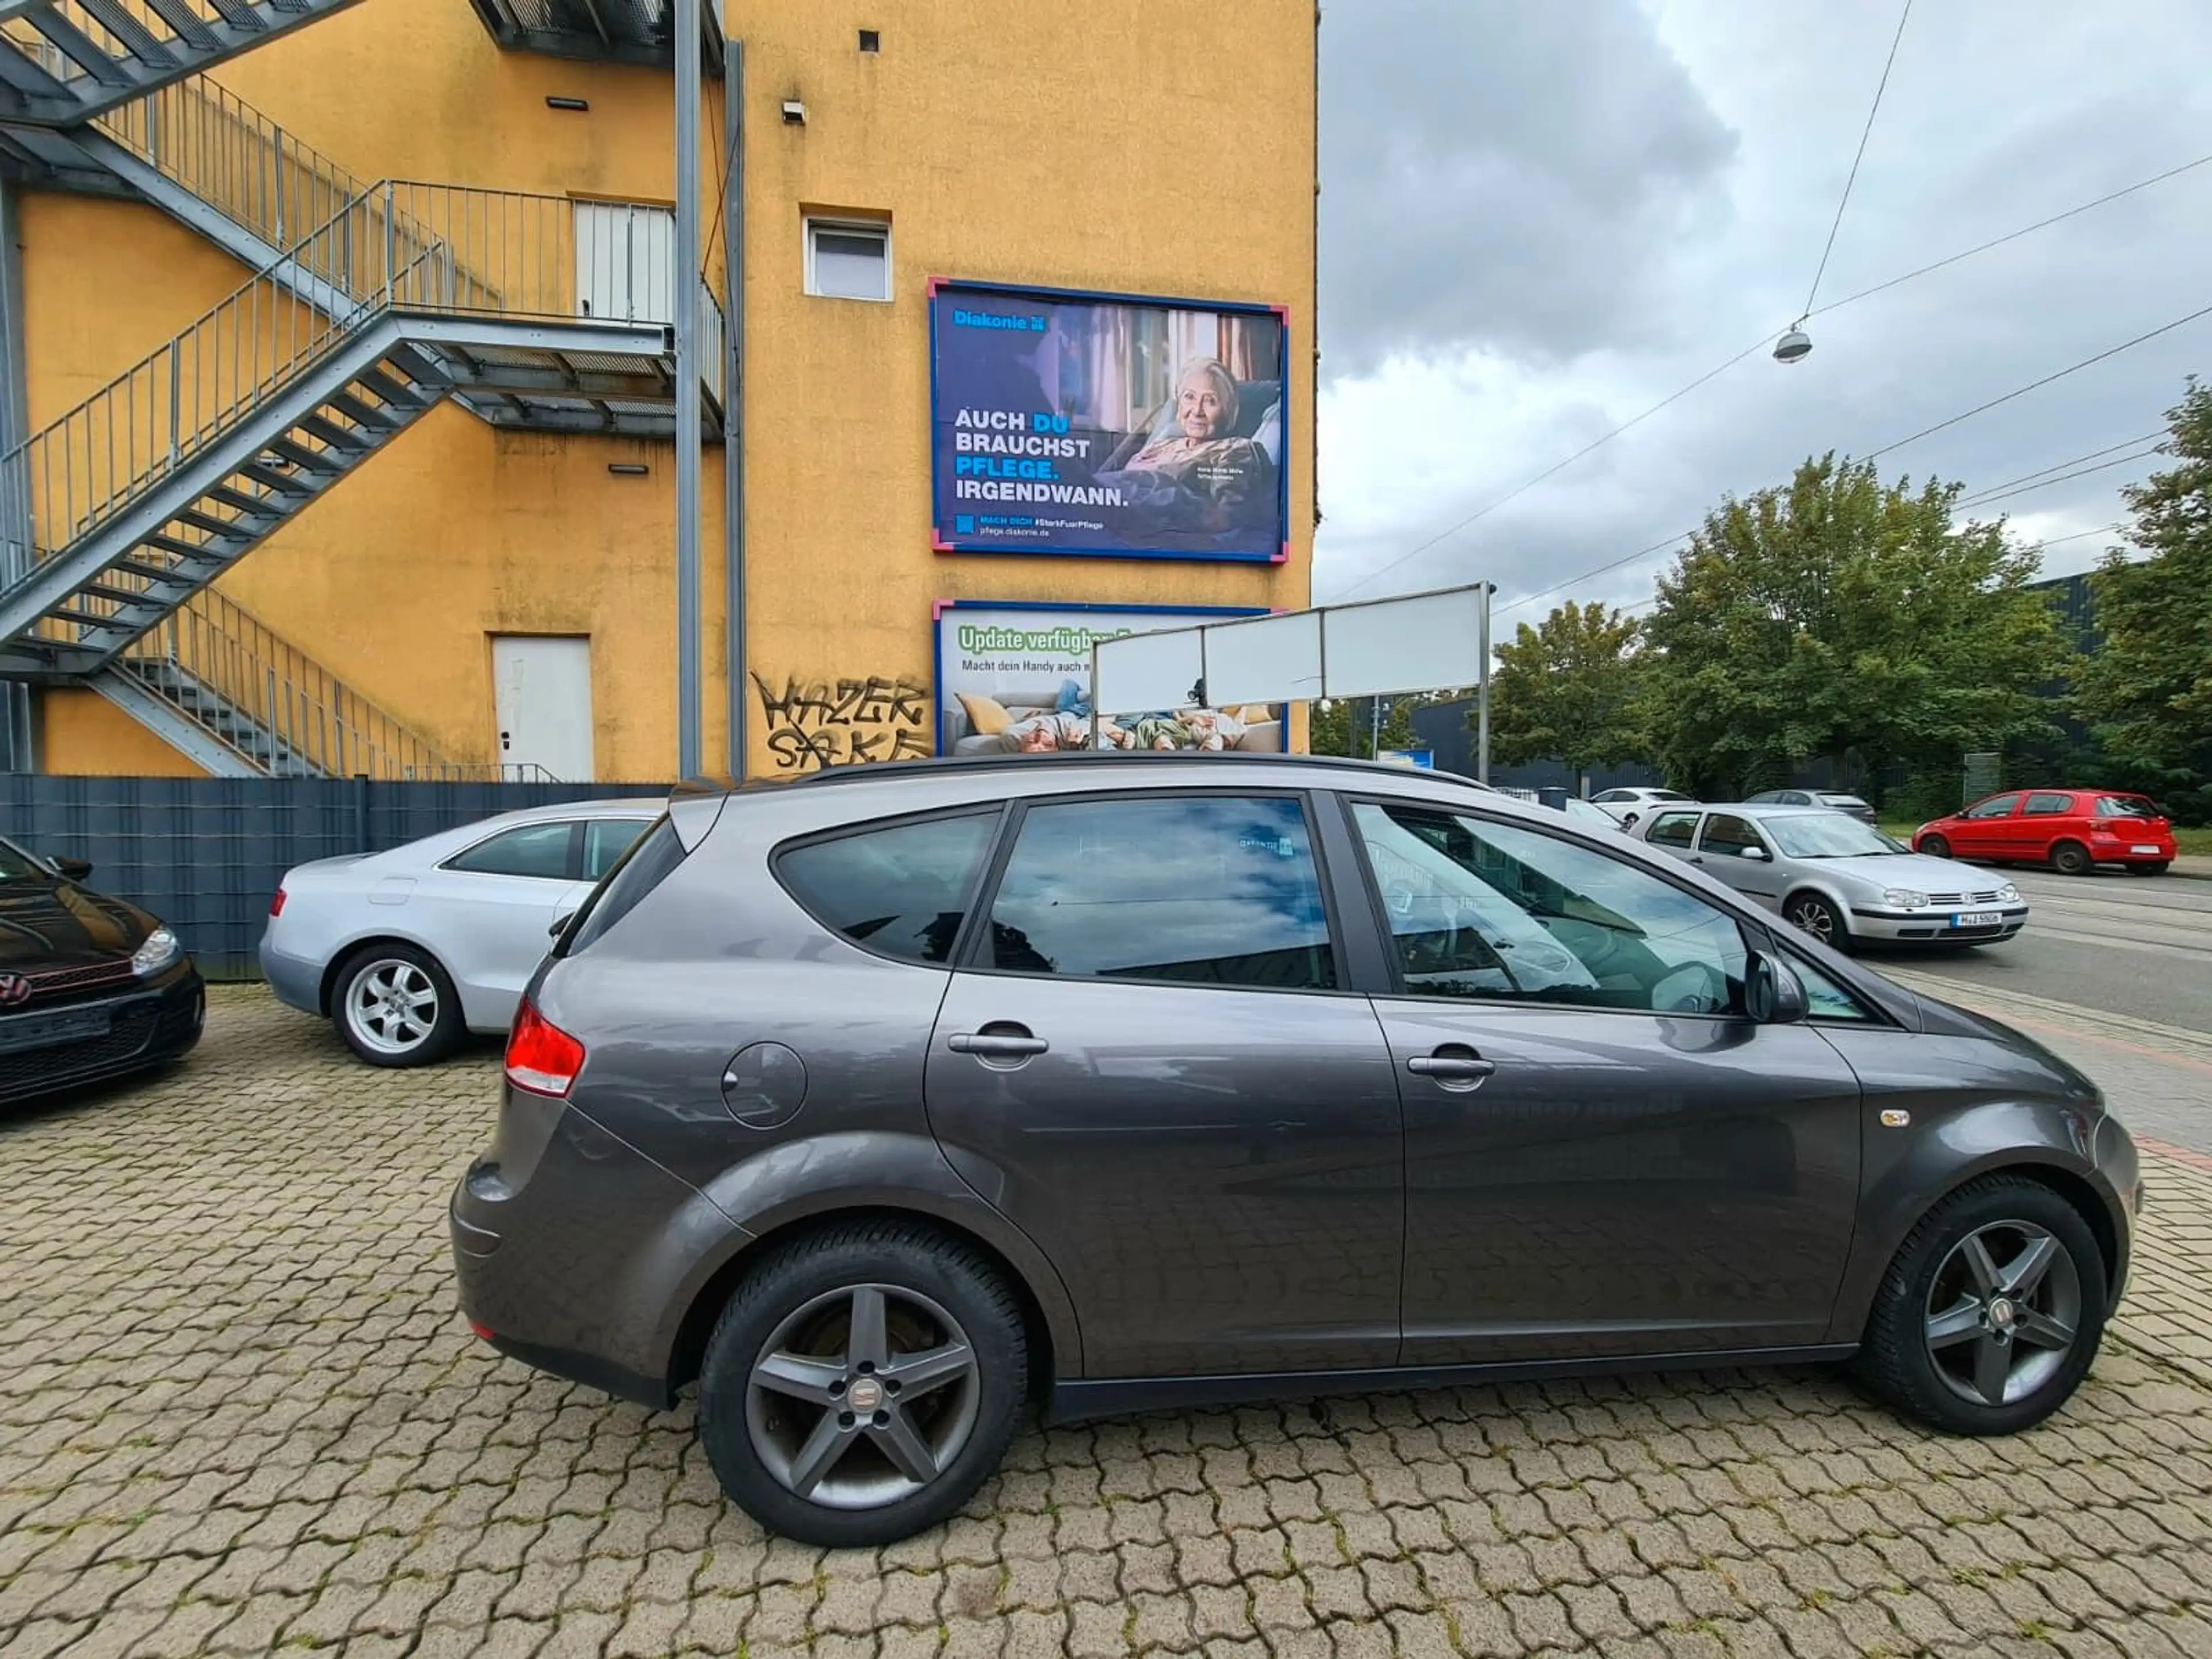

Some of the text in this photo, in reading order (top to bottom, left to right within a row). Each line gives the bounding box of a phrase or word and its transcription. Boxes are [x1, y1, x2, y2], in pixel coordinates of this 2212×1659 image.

[954, 310, 1027, 329] Diakonie
[955, 408, 1070, 433] AUCH DU
[956, 431, 1090, 458] BRAUCHST
[956, 455, 1059, 480] PFLEGE.
[956, 479, 1129, 506] IRGENDWANN.
[960, 628, 1023, 652] Update
[962, 660, 995, 671] Macht
[998, 660, 1020, 671] dein
[1023, 660, 1054, 673] Handy
[1058, 660, 1081, 672] auch
